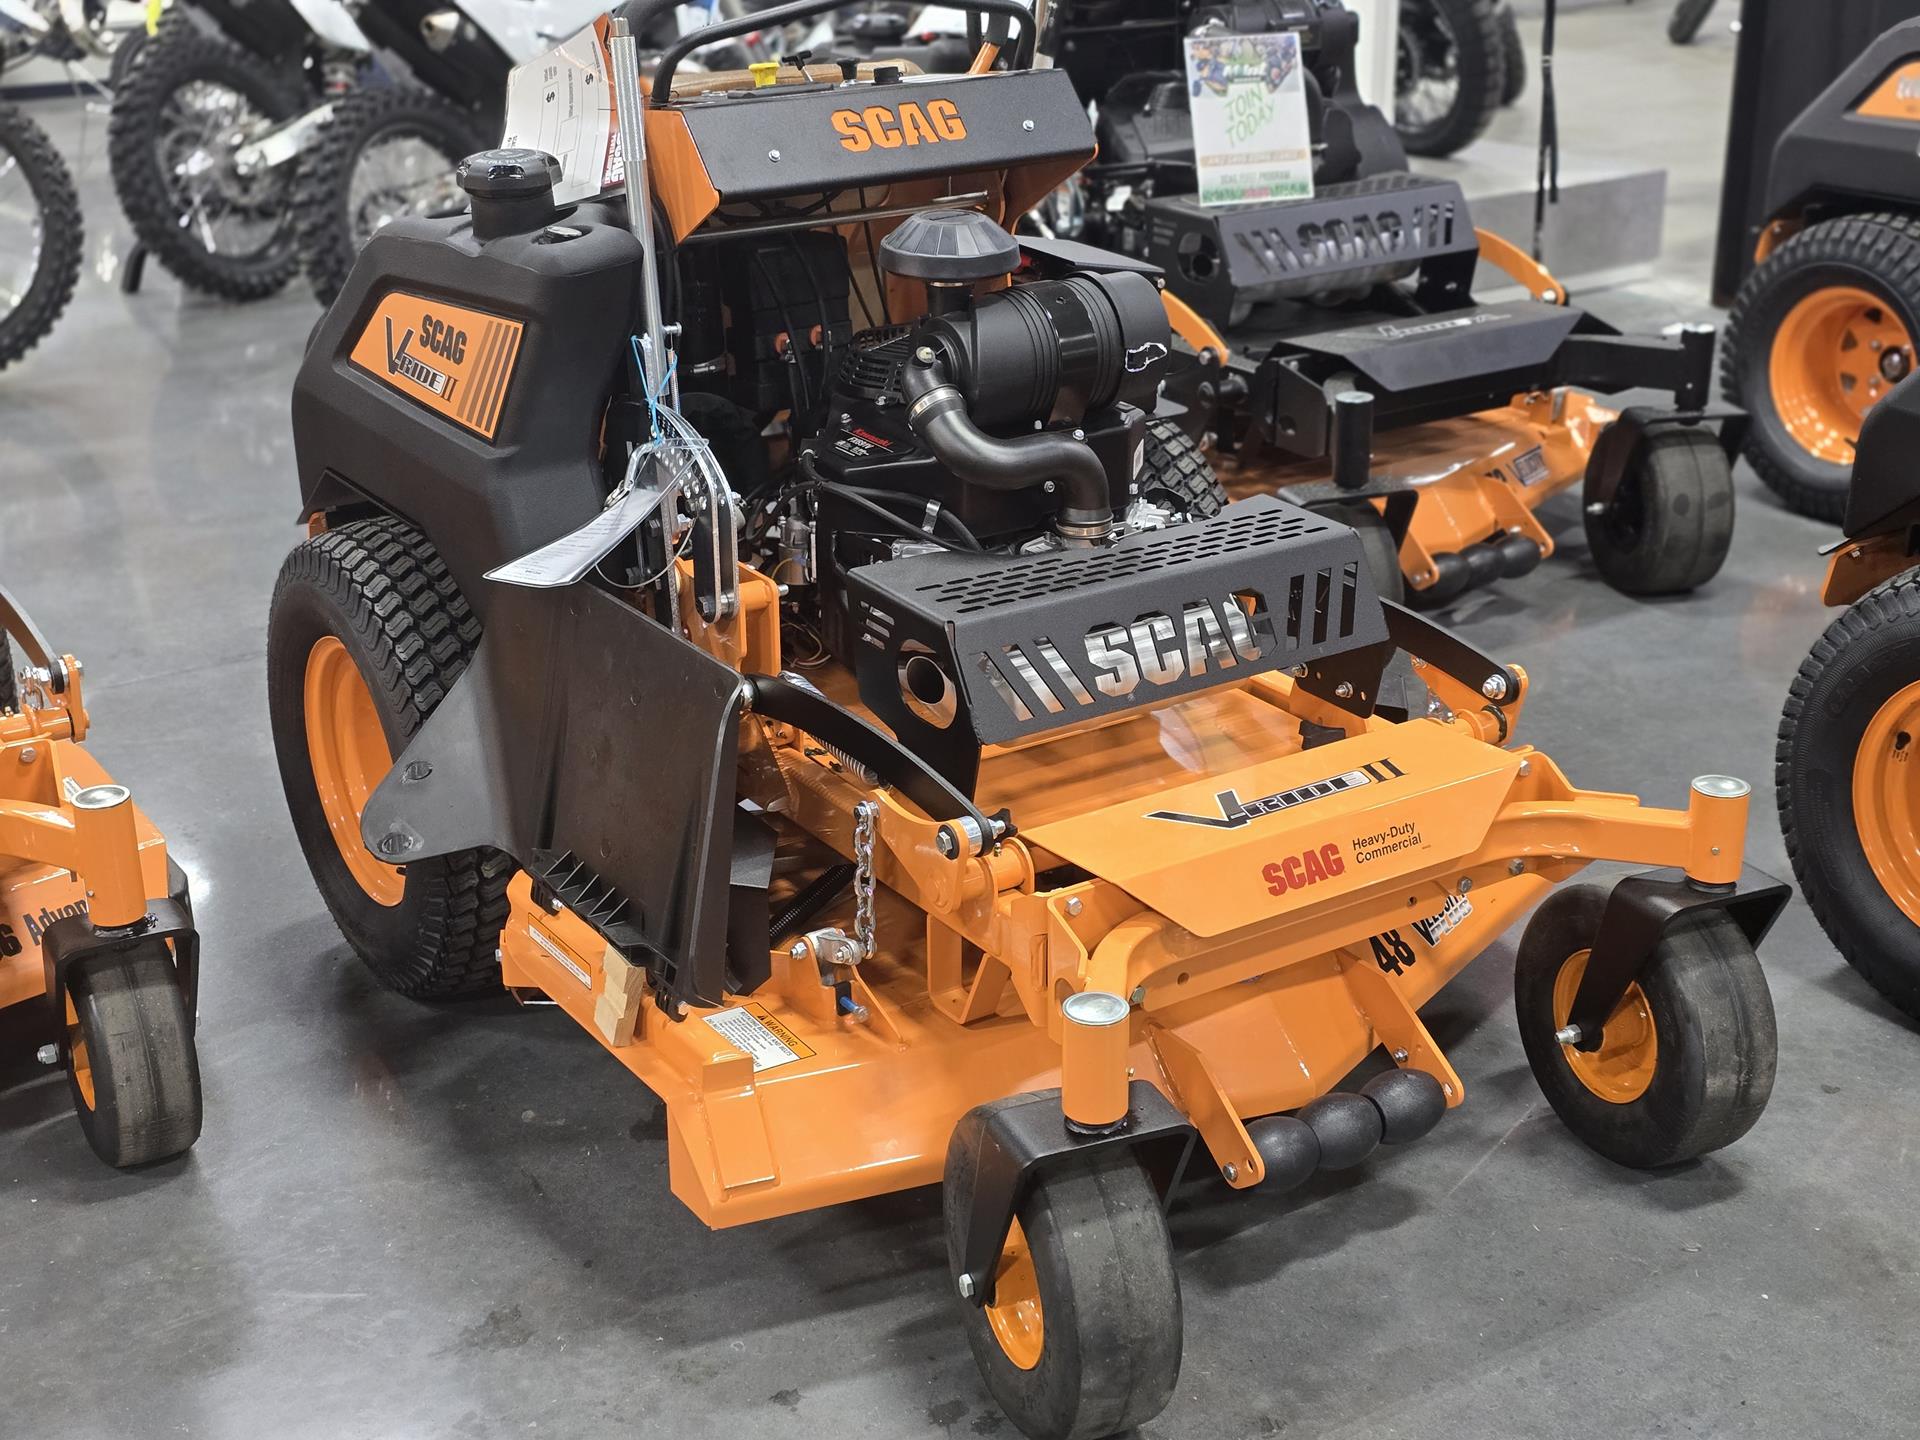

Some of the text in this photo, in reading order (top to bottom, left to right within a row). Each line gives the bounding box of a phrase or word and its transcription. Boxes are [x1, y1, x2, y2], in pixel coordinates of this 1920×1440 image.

[831, 98, 967, 153] SCAG
[1296, 210, 1405, 266] SCAG
[419, 314, 468, 366] SCAG
[1083, 586, 1278, 697] SCAG
[1352, 821, 1416, 851] Heavy-Duty
[1356, 834, 1422, 864] Commercial
[1262, 842, 1345, 897] SCAG
[1368, 929, 1417, 977] 48
[765, 1021, 798, 1046] WARNING
